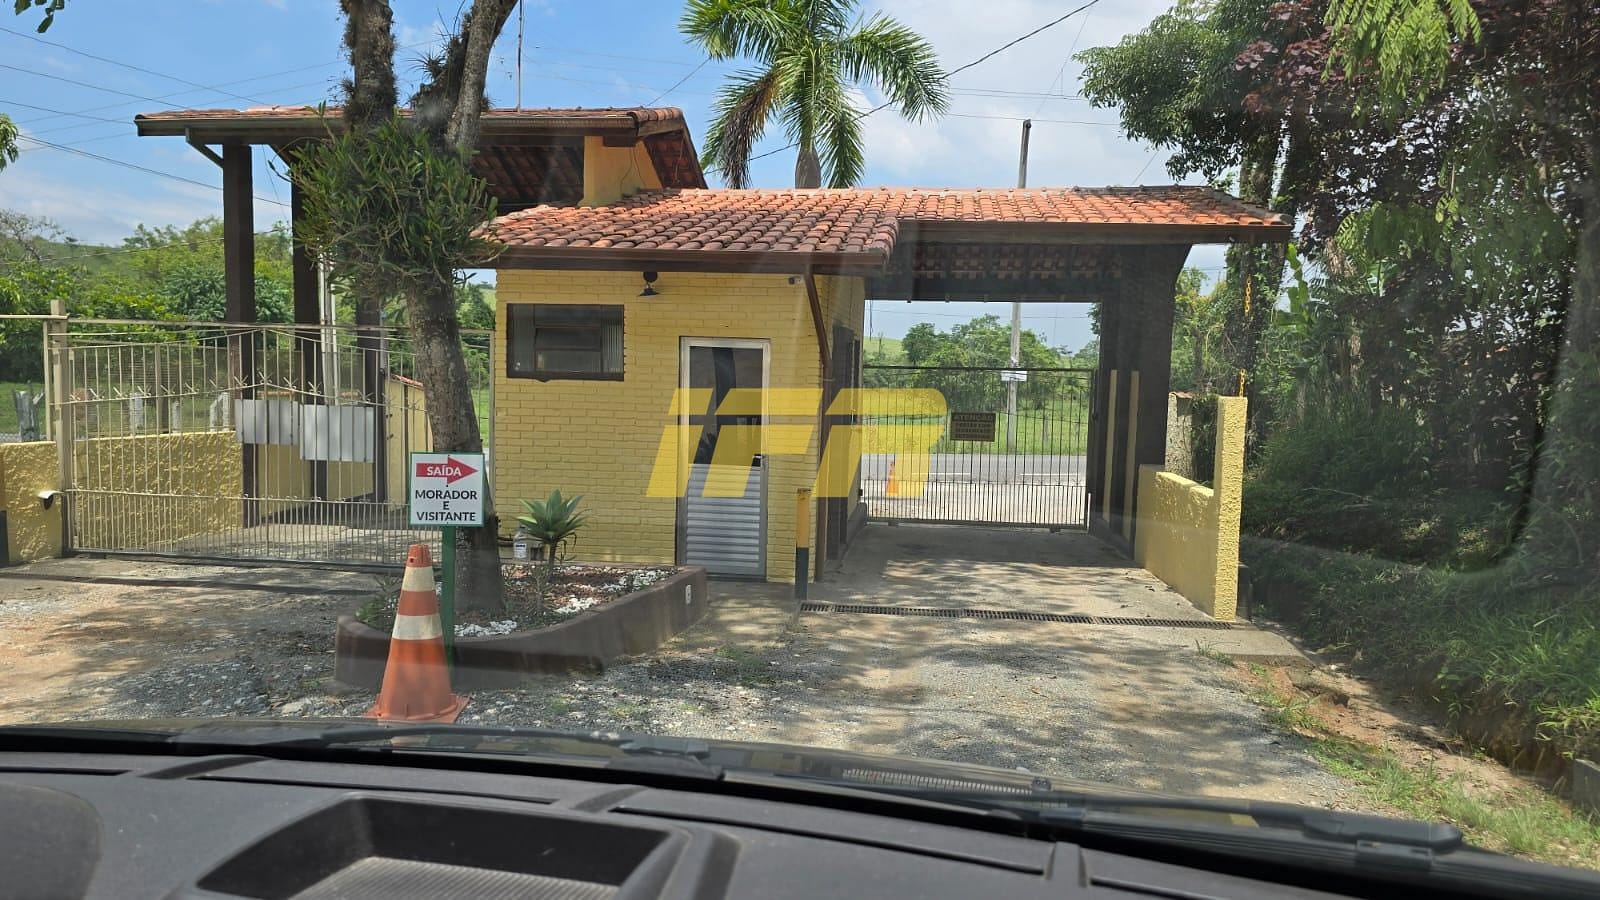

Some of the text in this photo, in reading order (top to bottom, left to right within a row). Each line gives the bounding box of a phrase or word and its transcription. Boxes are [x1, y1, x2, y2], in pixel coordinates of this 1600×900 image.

[426, 465, 462, 476] SAÍDA
[415, 490, 478, 500] MORADOR
[443, 501, 450, 510] E
[416, 512, 476, 521] VISITANTE
